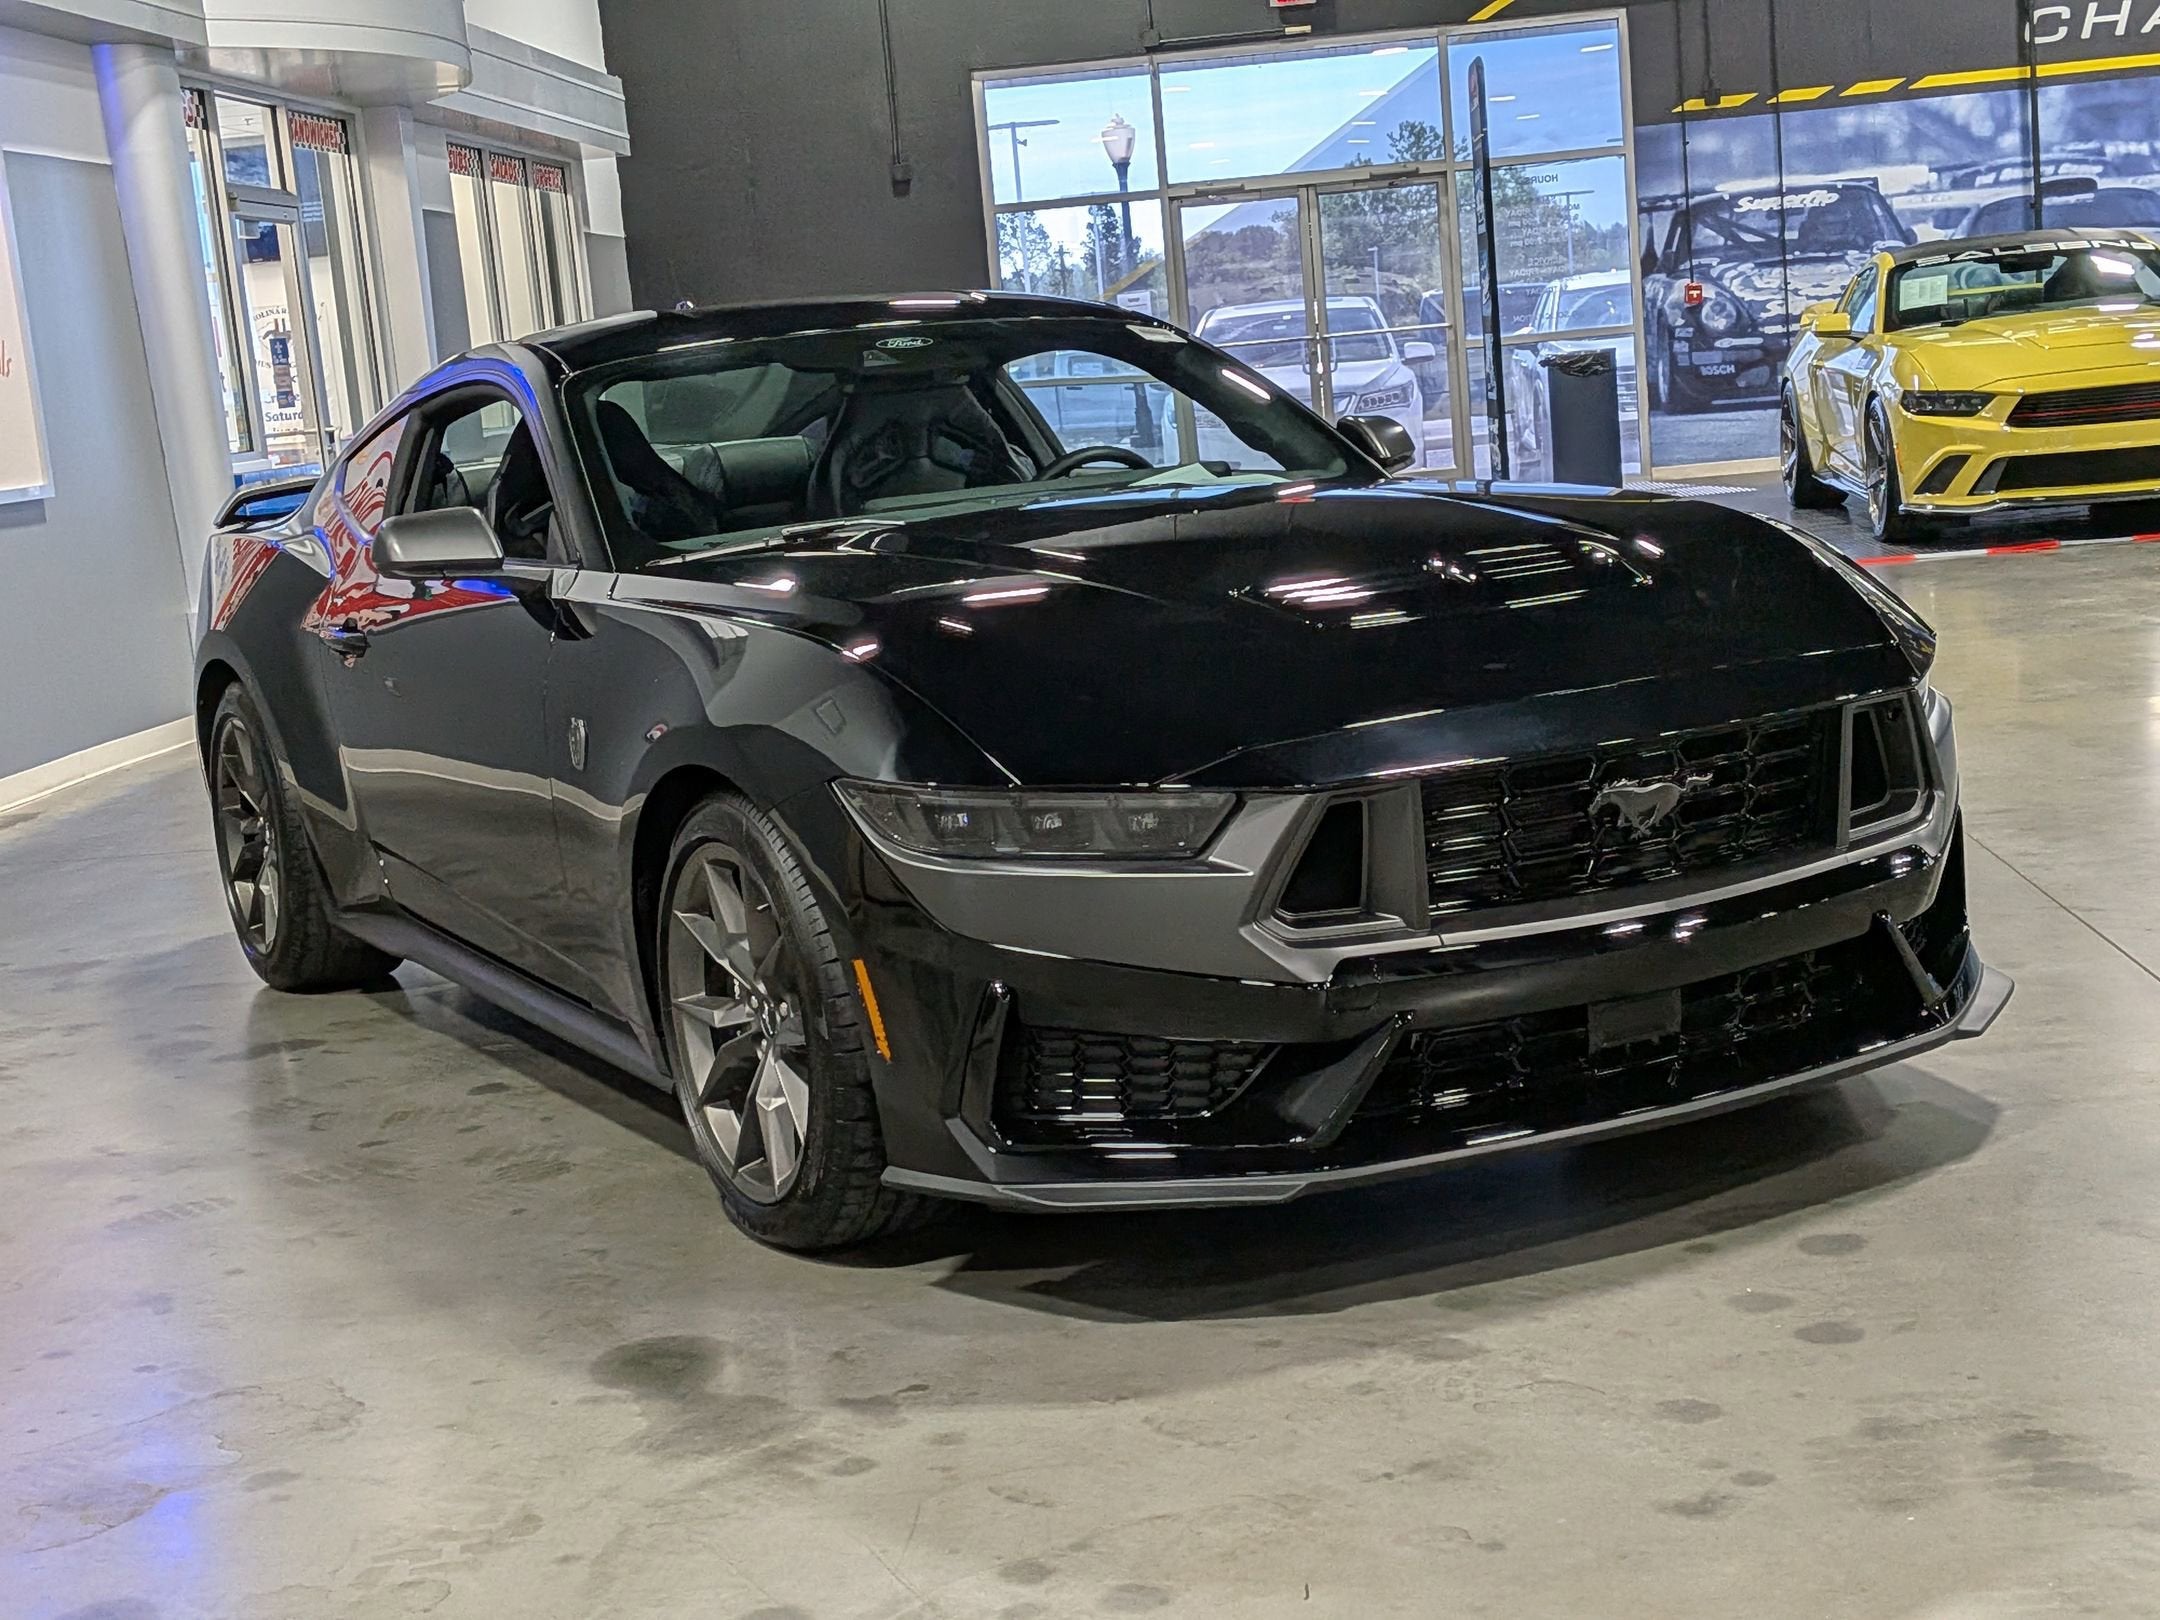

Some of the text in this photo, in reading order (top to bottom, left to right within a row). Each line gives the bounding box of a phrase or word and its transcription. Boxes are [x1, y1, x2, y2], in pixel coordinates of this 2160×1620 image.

[448, 147, 469, 173] SUBS
[491, 158, 519, 182] SALADS
[534, 168, 562, 190] URGERS
[887, 339, 923, 348] Ford
